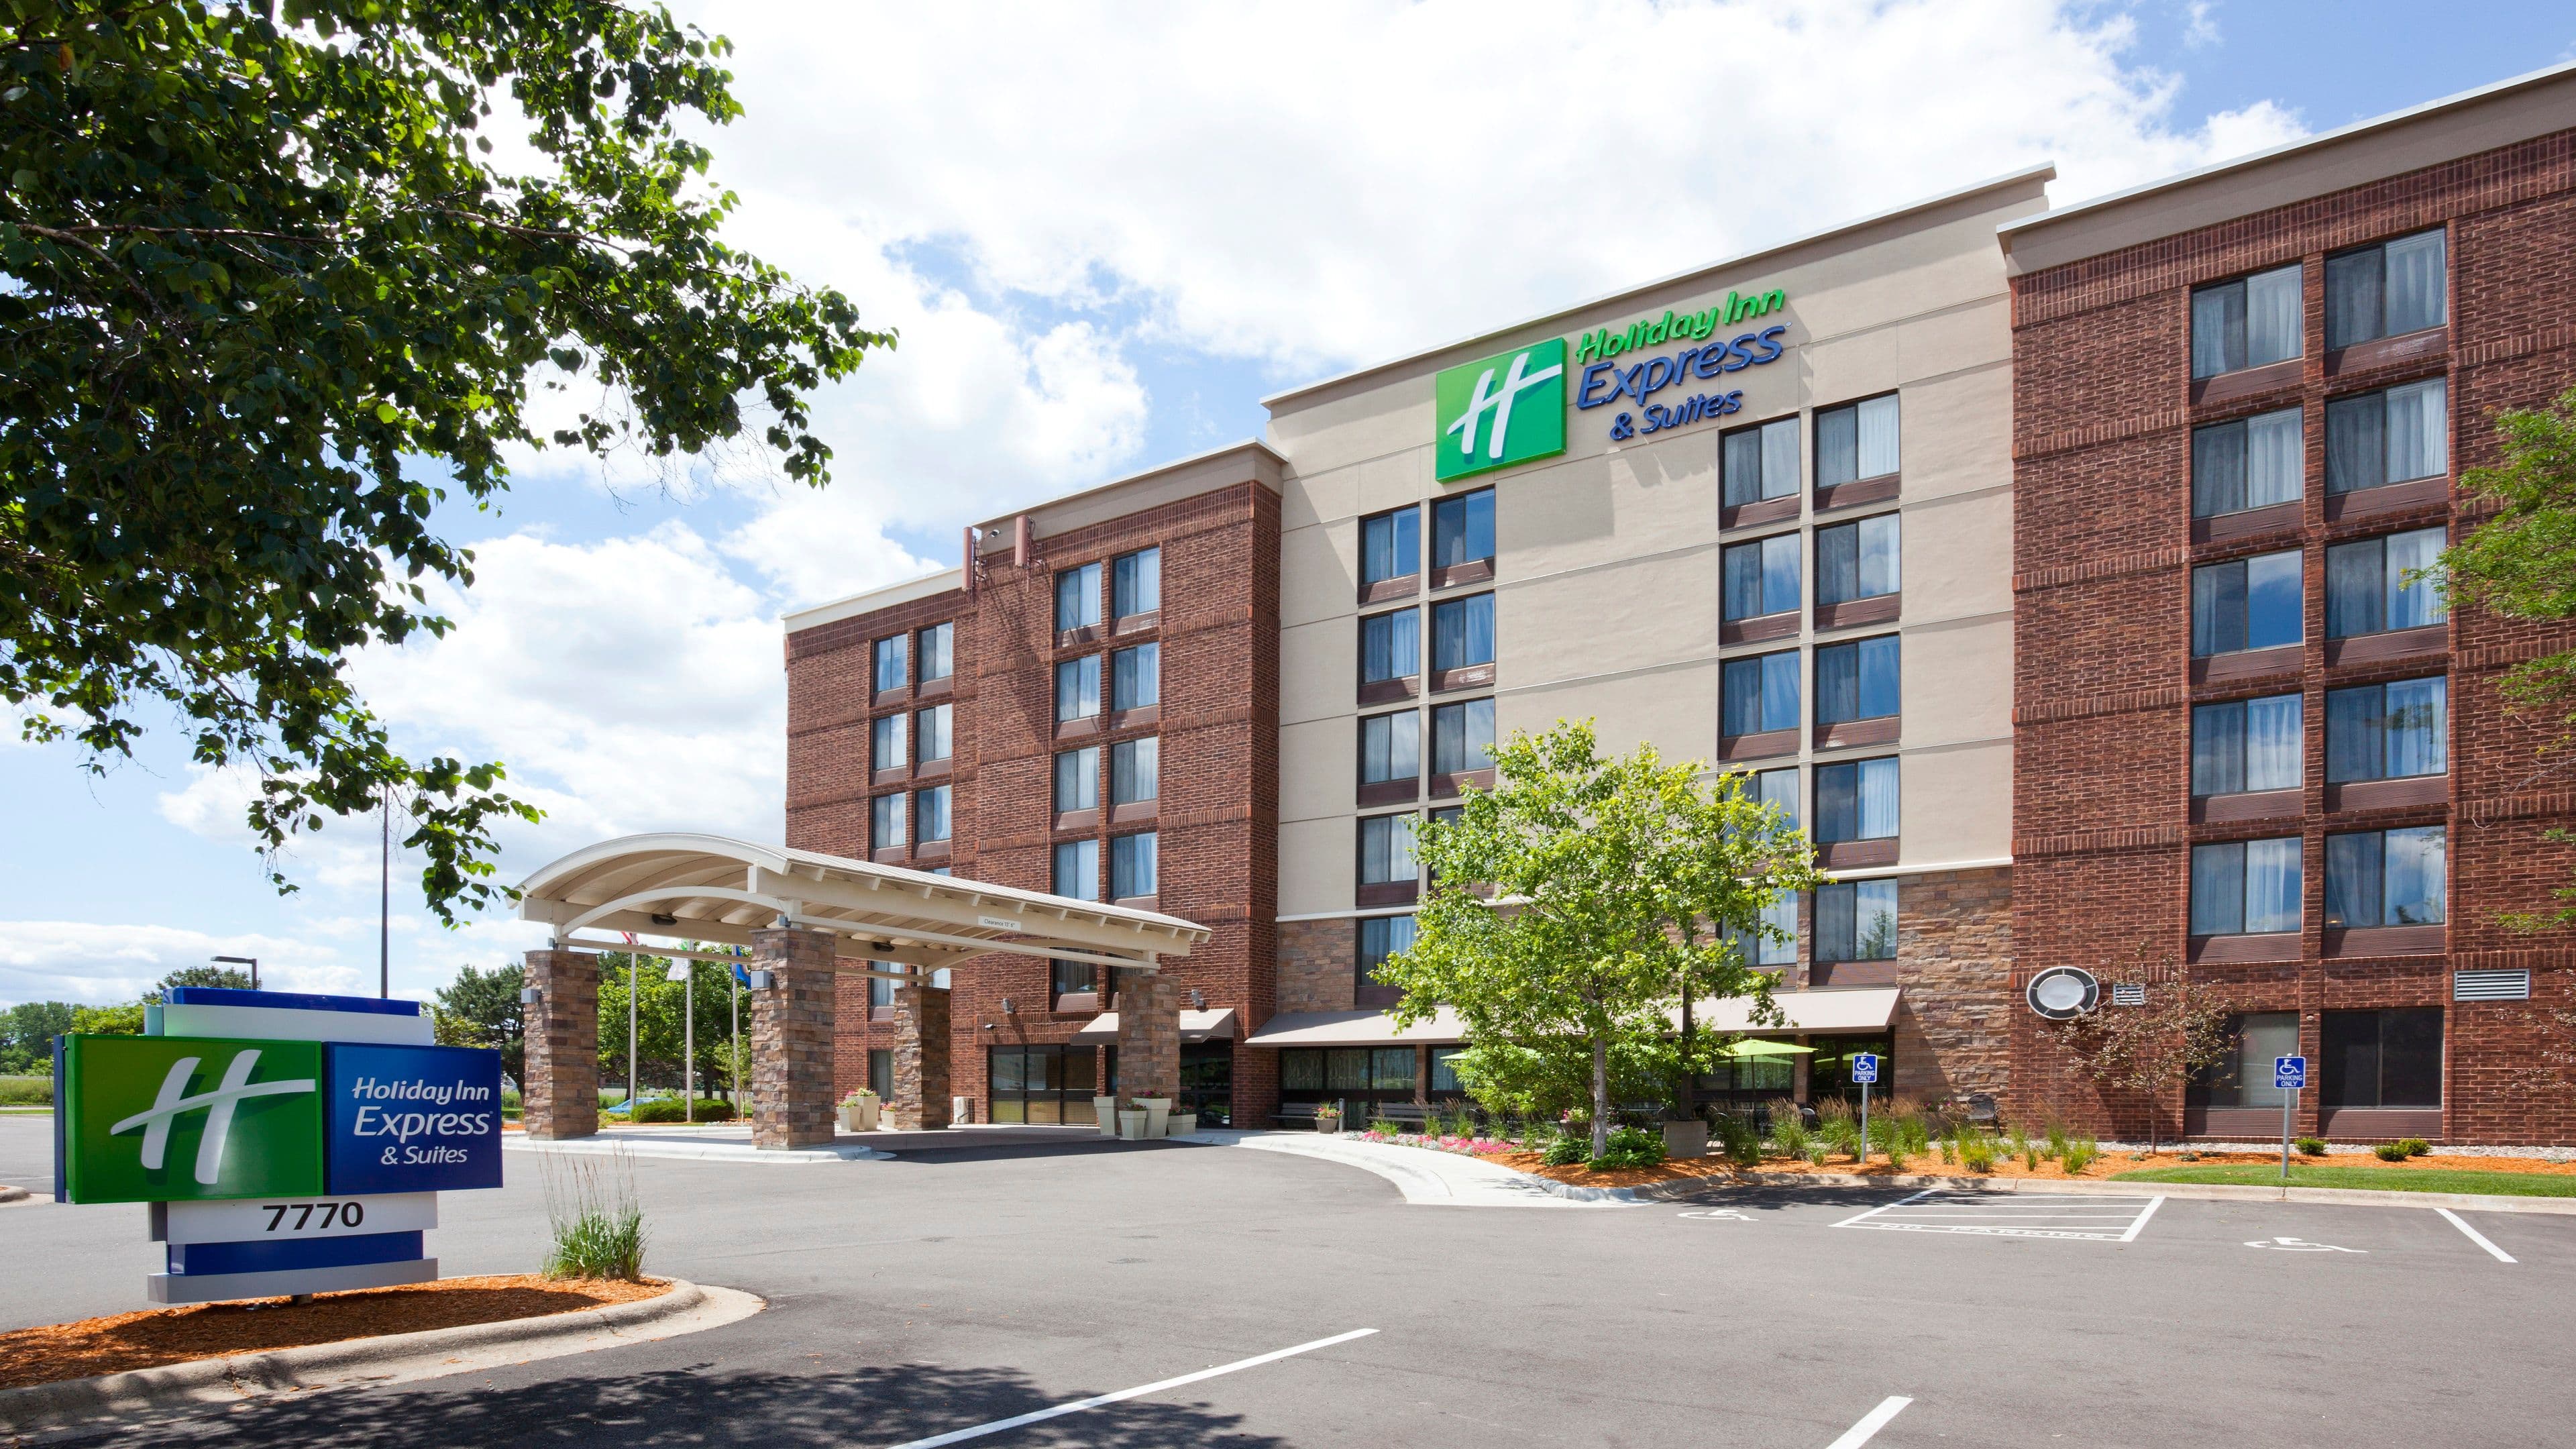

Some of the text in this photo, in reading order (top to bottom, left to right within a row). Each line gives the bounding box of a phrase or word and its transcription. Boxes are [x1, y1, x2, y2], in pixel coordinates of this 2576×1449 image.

[1575, 289, 1784, 365] Holiday Inn
[1576, 325, 1786, 411] Express
[1610, 390, 1743, 441] & Suites
[984, 918, 1004, 926] Clearance
[352, 1077, 489, 1105] Holiday Inn
[354, 1106, 490, 1144] Express
[380, 1146, 468, 1165] & Suites
[263, 1201, 364, 1232] 7770
[1949, 1227, 2106, 1239] PARKING
